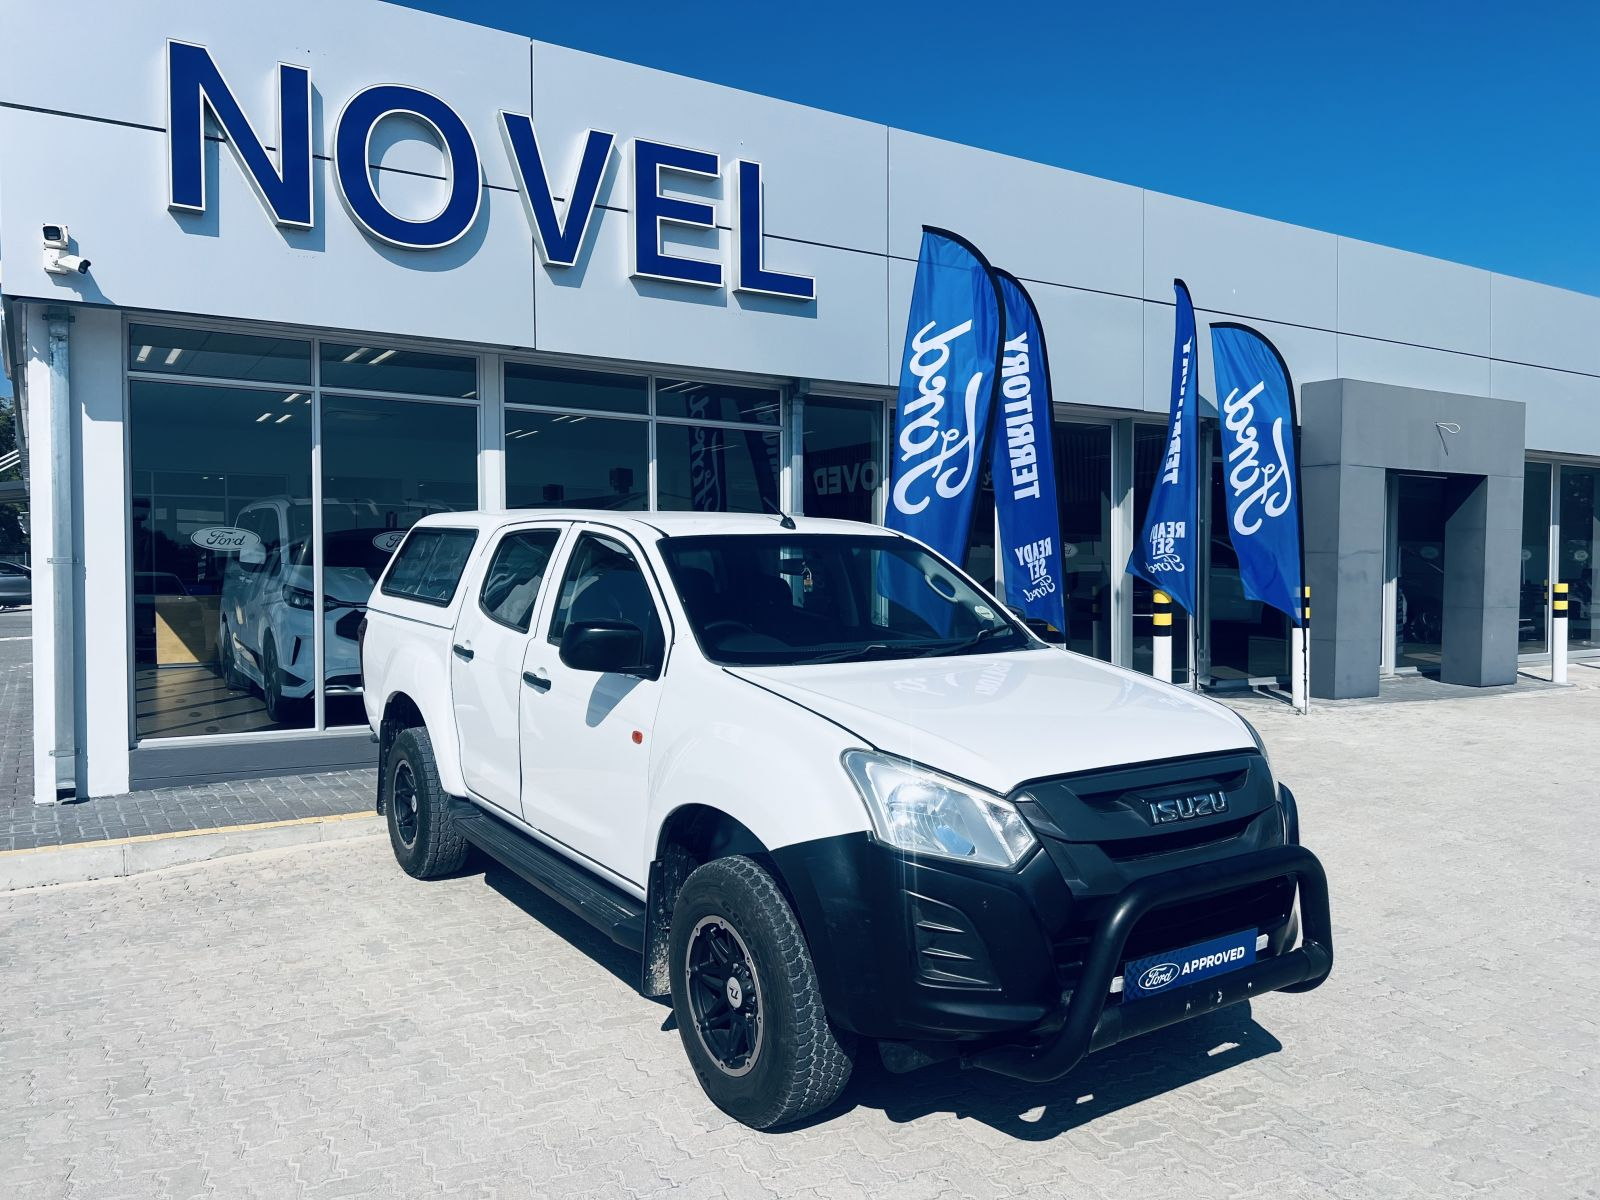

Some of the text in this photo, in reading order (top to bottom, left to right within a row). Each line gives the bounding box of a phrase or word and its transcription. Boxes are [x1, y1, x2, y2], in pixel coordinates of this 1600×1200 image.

[167, 38, 816, 301] NOVEL
[1150, 791, 1226, 824] ISUZU
[1145, 946, 1245, 987] Ford APPROVED
